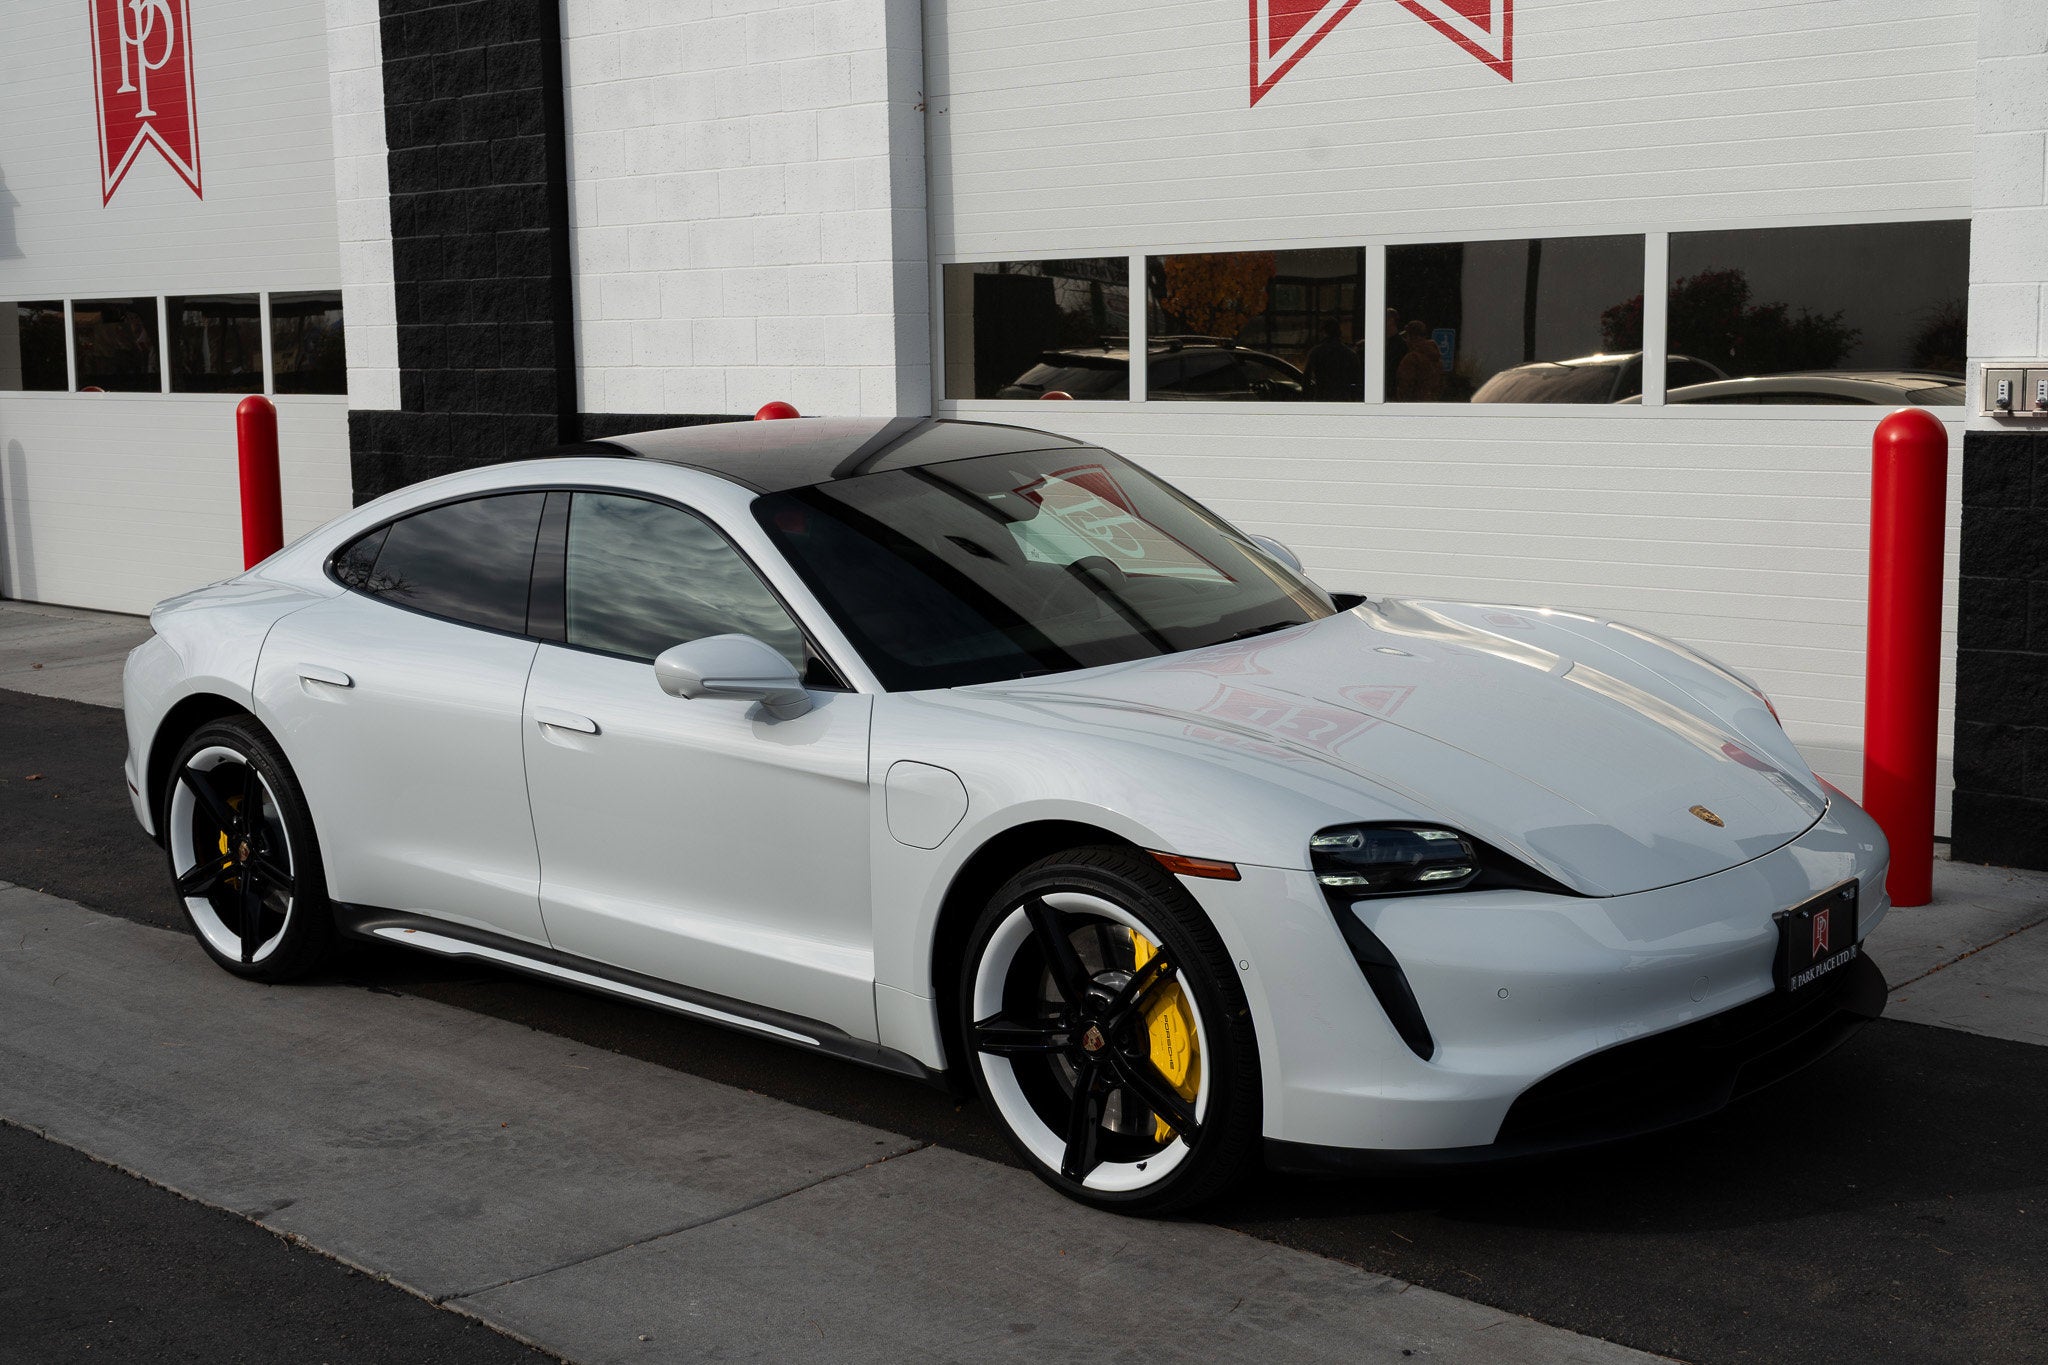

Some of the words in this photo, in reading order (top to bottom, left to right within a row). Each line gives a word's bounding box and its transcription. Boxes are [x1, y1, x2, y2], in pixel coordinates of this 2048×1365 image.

[1798, 967, 1815, 987] PARK
[1815, 956, 1835, 978] PLACE
[1836, 950, 1849, 966] LTD
[1163, 1014, 1174, 1070] PORSCHE
